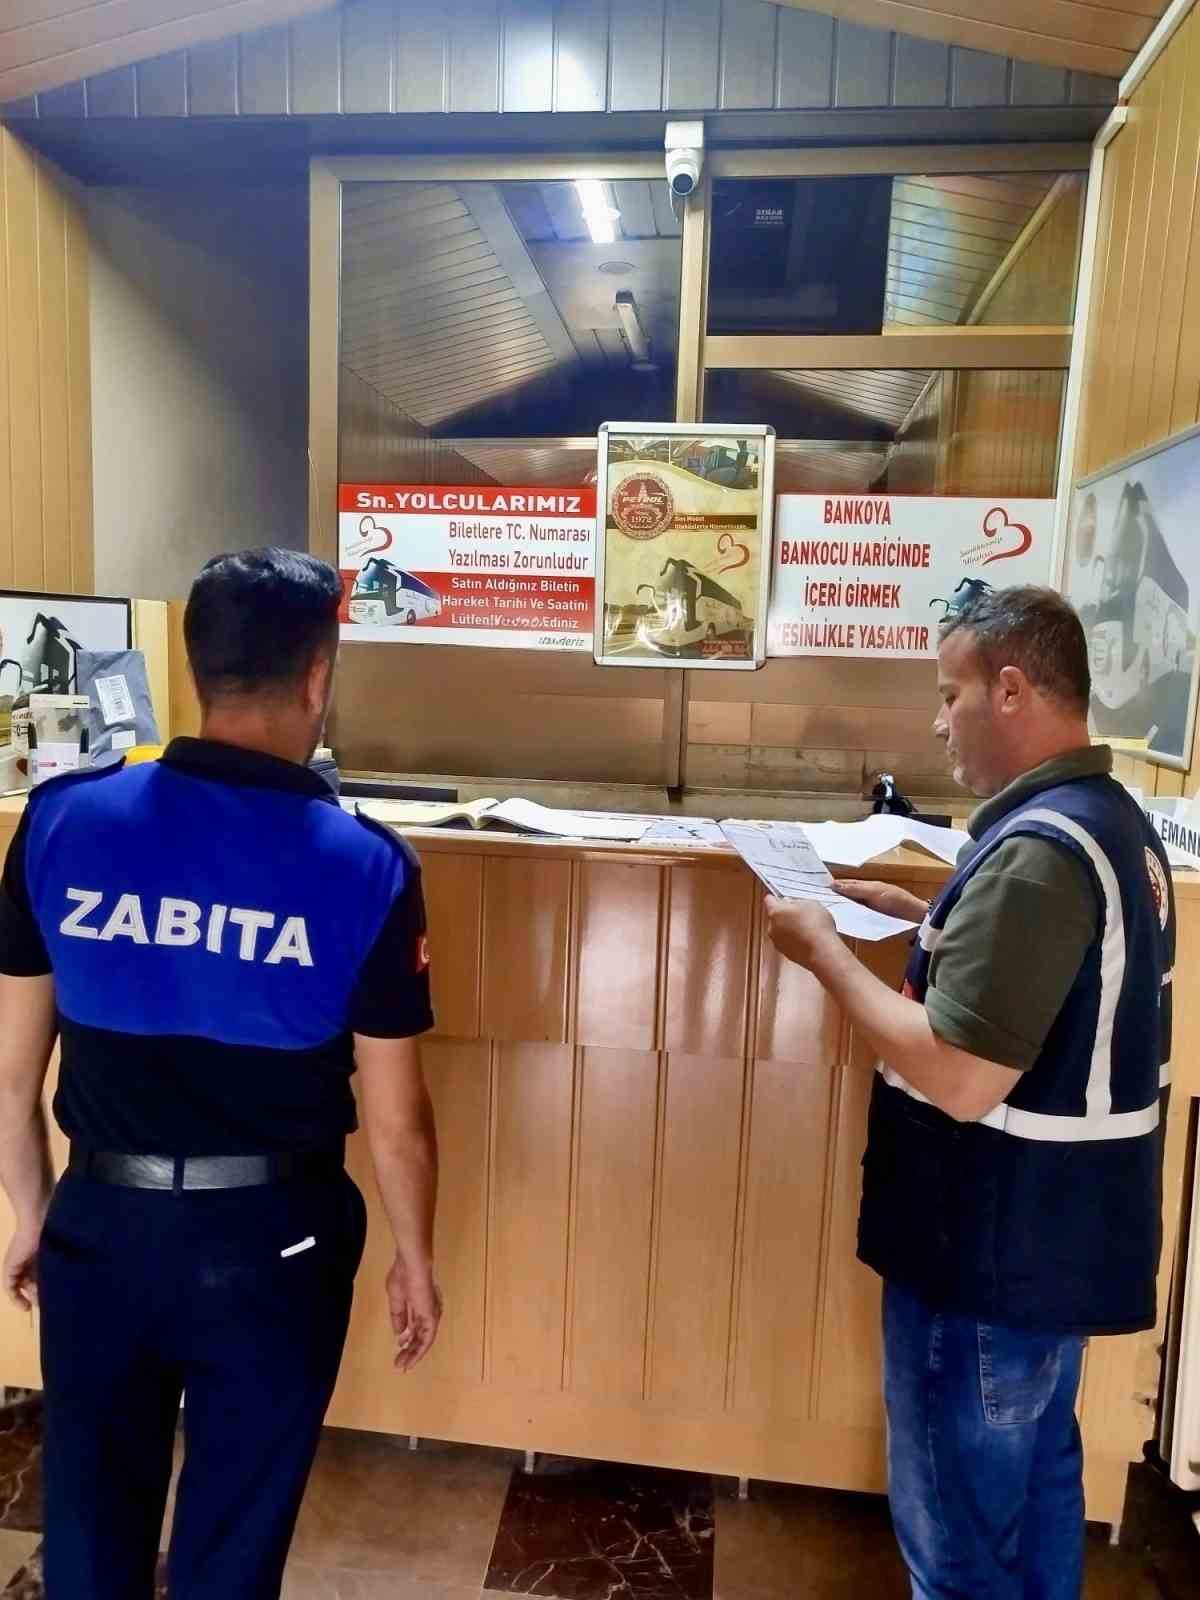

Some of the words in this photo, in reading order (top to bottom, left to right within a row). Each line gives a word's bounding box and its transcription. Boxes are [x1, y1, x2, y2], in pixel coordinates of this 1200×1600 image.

[823, 499, 892, 526] BANKOYA
[449, 521, 502, 540] Biletlere
[506, 525, 526, 541] TC.
[529, 526, 591, 543] Numarası
[449, 549, 510, 569] Yazılması
[513, 552, 589, 570] Zorunludur
[780, 540, 849, 567] BANKOCU
[451, 577, 482, 589] Satın
[485, 579, 537, 593] Aldığınız
[540, 581, 580, 593] Biletin
[804, 576, 842, 613] İÇERİ
[845, 576, 901, 608] GİRMEK
[442, 595, 489, 608] Hareket
[493, 597, 527, 609] Tarihi
[530, 600, 545, 609] Ve
[547, 600, 589, 612] Saatini
[543, 617, 579, 629] Ediniz
[774, 617, 855, 648] ESİNLİKLE
[858, 624, 929, 650] YASAKTIR
[59, 888, 315, 967] ZABITA
